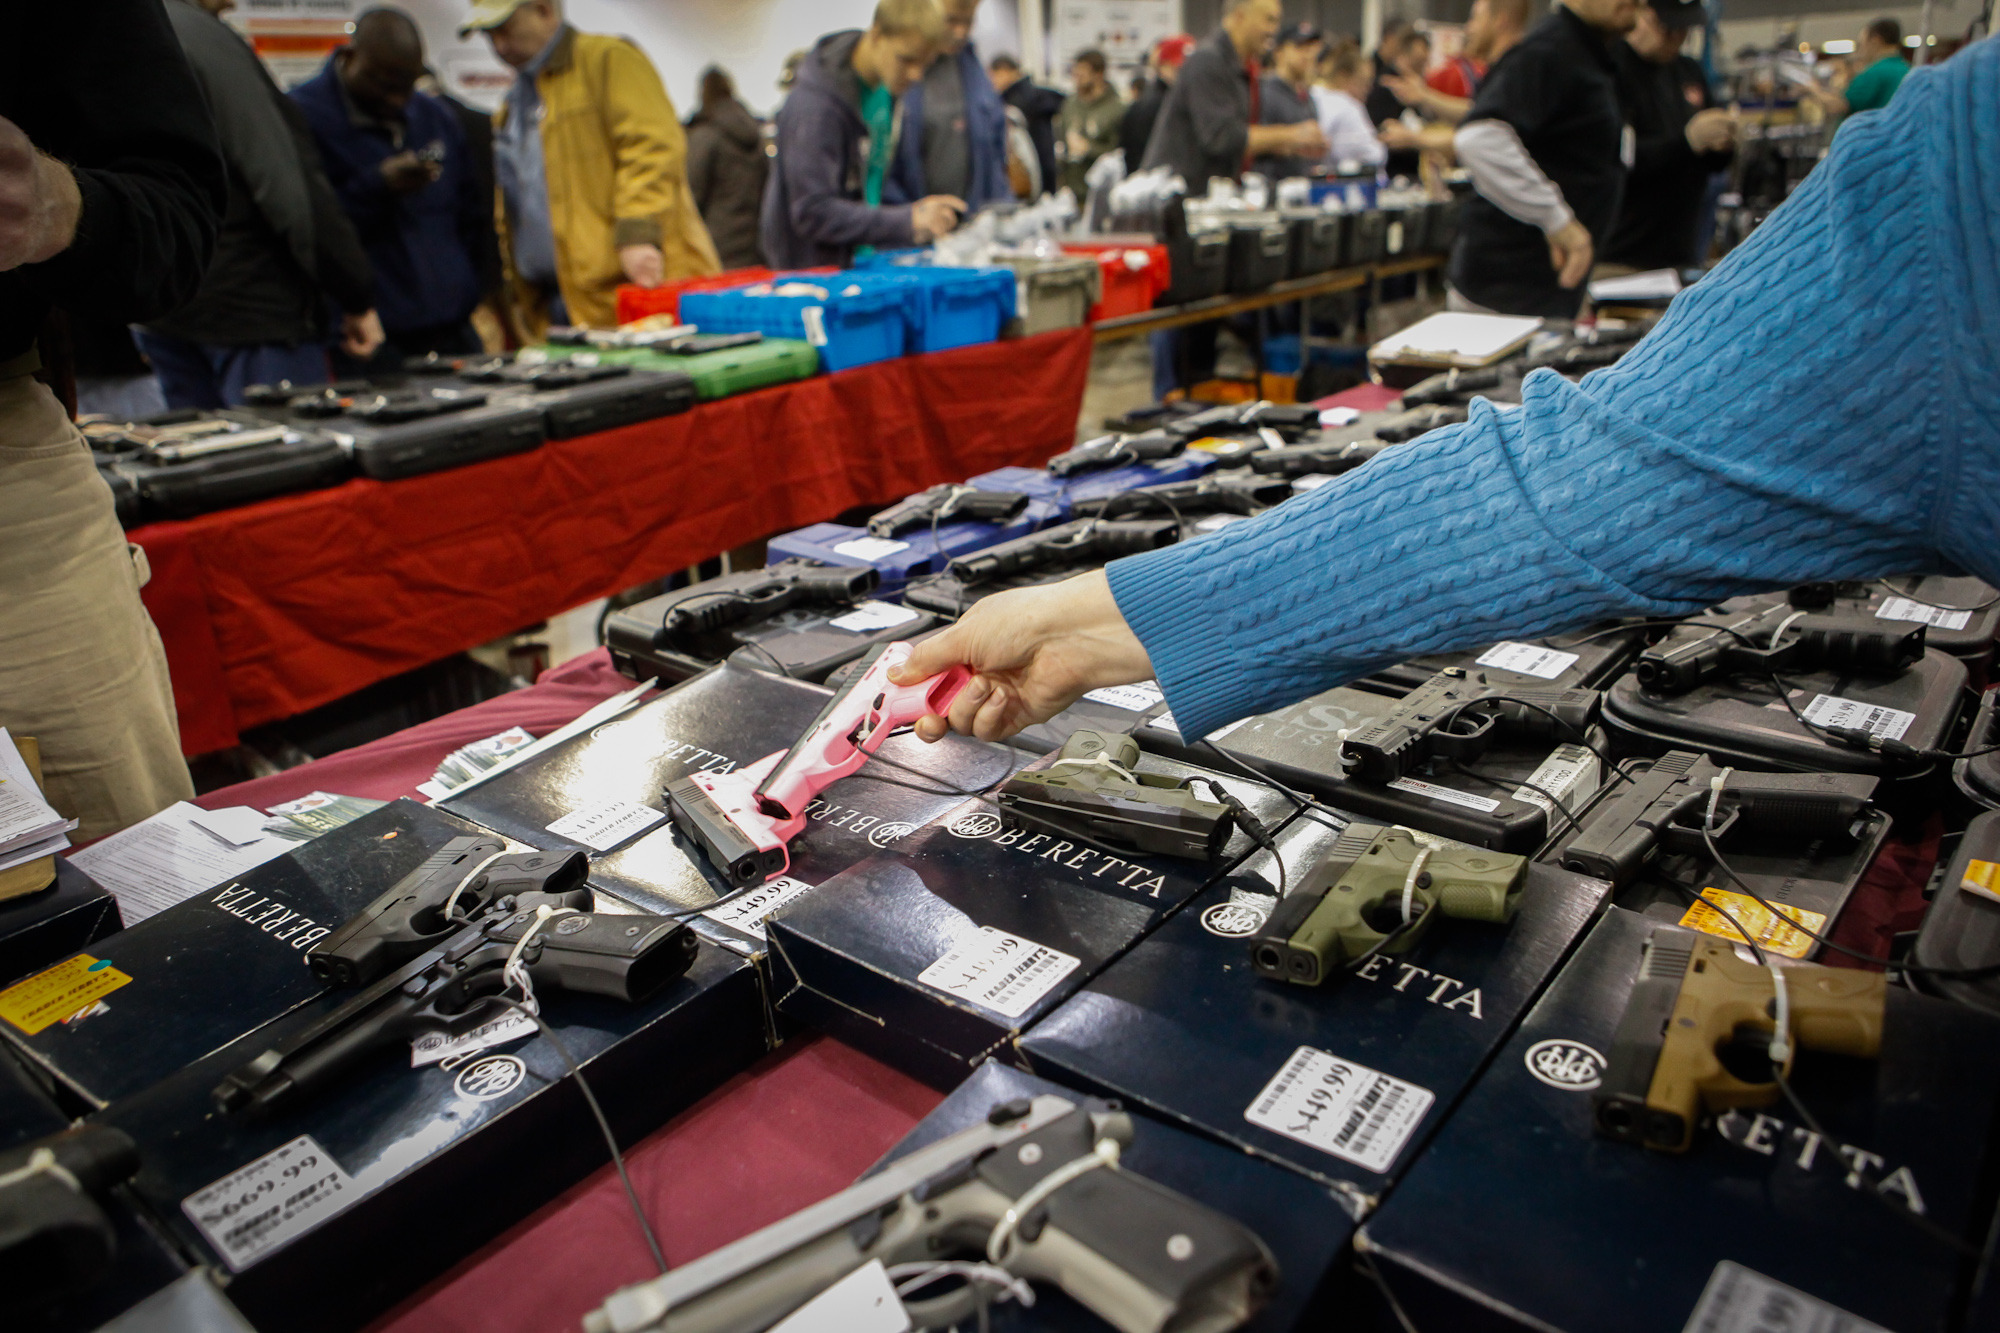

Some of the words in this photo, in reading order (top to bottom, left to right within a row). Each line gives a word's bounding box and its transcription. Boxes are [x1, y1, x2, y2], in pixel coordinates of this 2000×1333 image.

[1829, 702, 1857, 726] 539.99
[664, 740, 737, 776] ETTA
[1537, 768, 1555, 784] SPORTS
[585, 822, 619, 842] TRADER
[804, 798, 880, 834] BERE
[993, 828, 1166, 898] BERETTA
[211, 882, 331, 950] BERETTA
[723, 880, 792, 924] $449.99
[949, 938, 1019, 990] $449.99
[983, 973, 1018, 1001] TRADER
[1015, 947, 1048, 975] JERRY'S
[1356, 953, 1482, 1019] ETTA
[446, 1016, 524, 1046] BERETTA
[1287, 1063, 1353, 1134] $449.99
[1717, 1109, 1926, 1216] ETTA
[202, 1155, 318, 1225] $669.99
